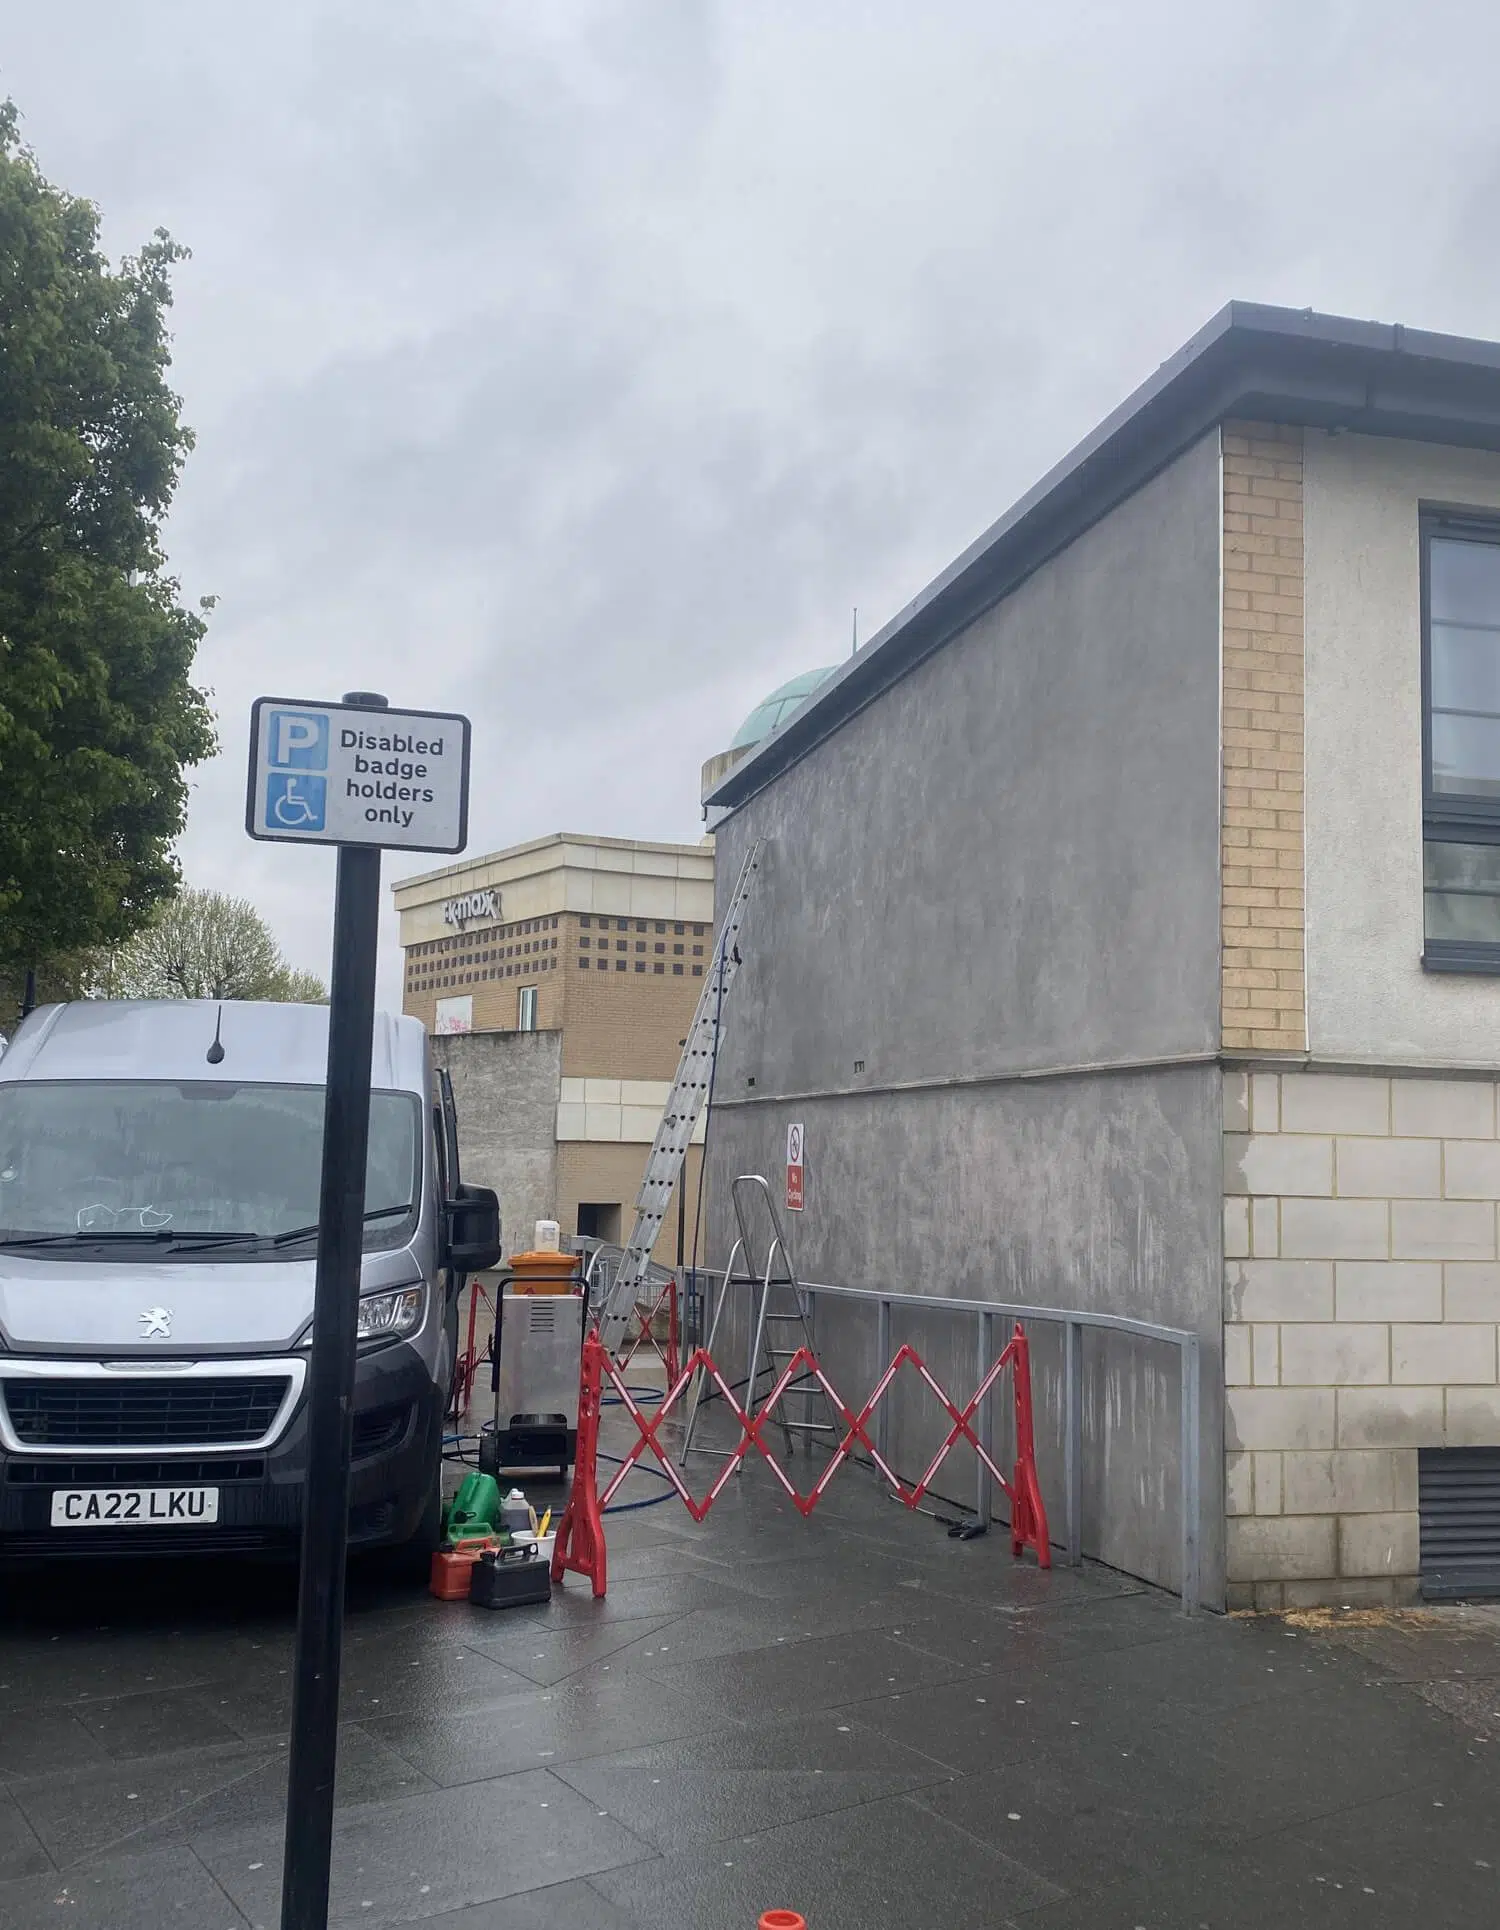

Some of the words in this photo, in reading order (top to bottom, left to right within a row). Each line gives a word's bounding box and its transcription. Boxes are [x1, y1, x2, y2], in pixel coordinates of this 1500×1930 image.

[277, 716, 319, 764] P
[340, 729, 444, 756] Disabled
[354, 755, 428, 779] badge
[346, 779, 434, 802] holders
[365, 805, 414, 827] only
[65, 1493, 141, 1520] CA22
[150, 1491, 206, 1518] LKU
